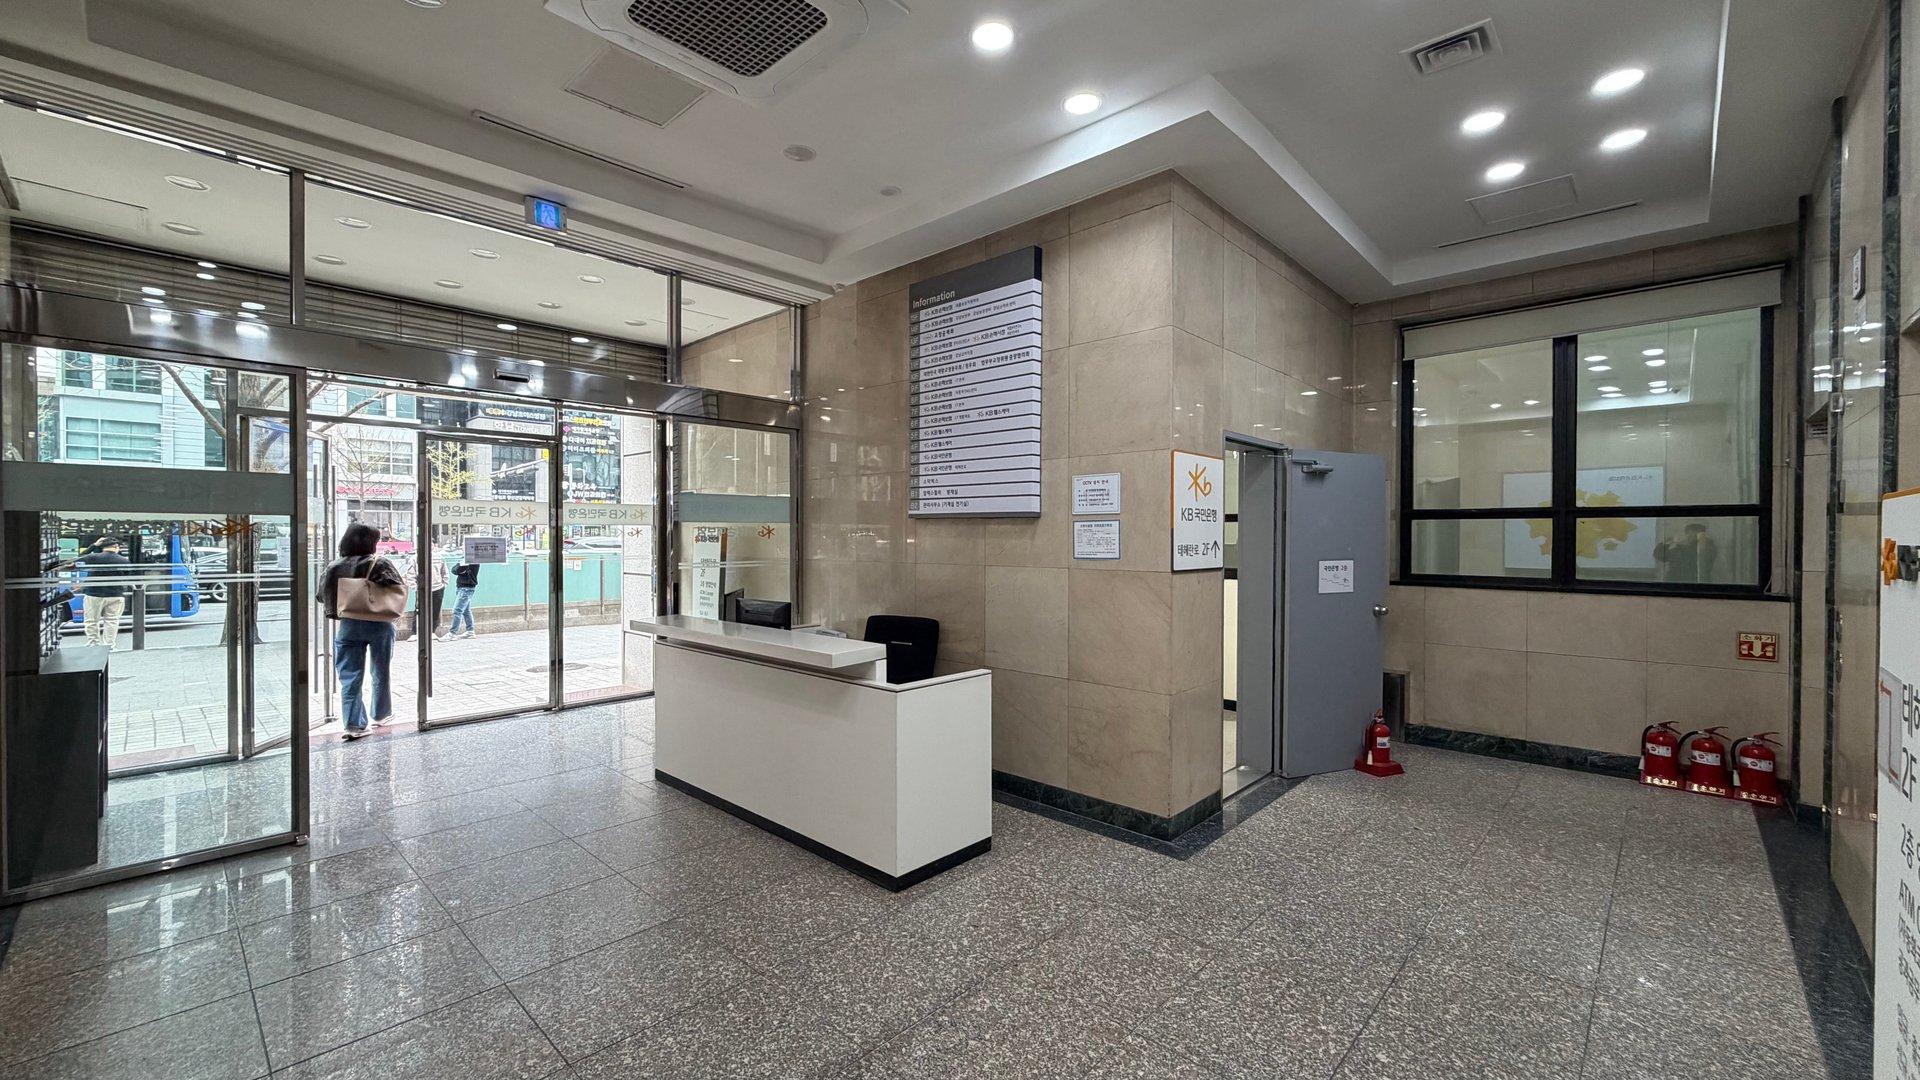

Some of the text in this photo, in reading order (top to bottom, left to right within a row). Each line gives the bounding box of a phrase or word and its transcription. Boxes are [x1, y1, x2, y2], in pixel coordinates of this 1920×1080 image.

[912, 290, 955, 308] Information
[1181, 508, 1217, 522] KB국민은행
[1178, 543, 1210, 556] 테헤란로 2F
[1744, 634, 1774, 642] 소화기
[1902, 746, 1917, 802] 2F
[1901, 823, 1914, 869] 2층
[1899, 878, 1915, 925] ATM
